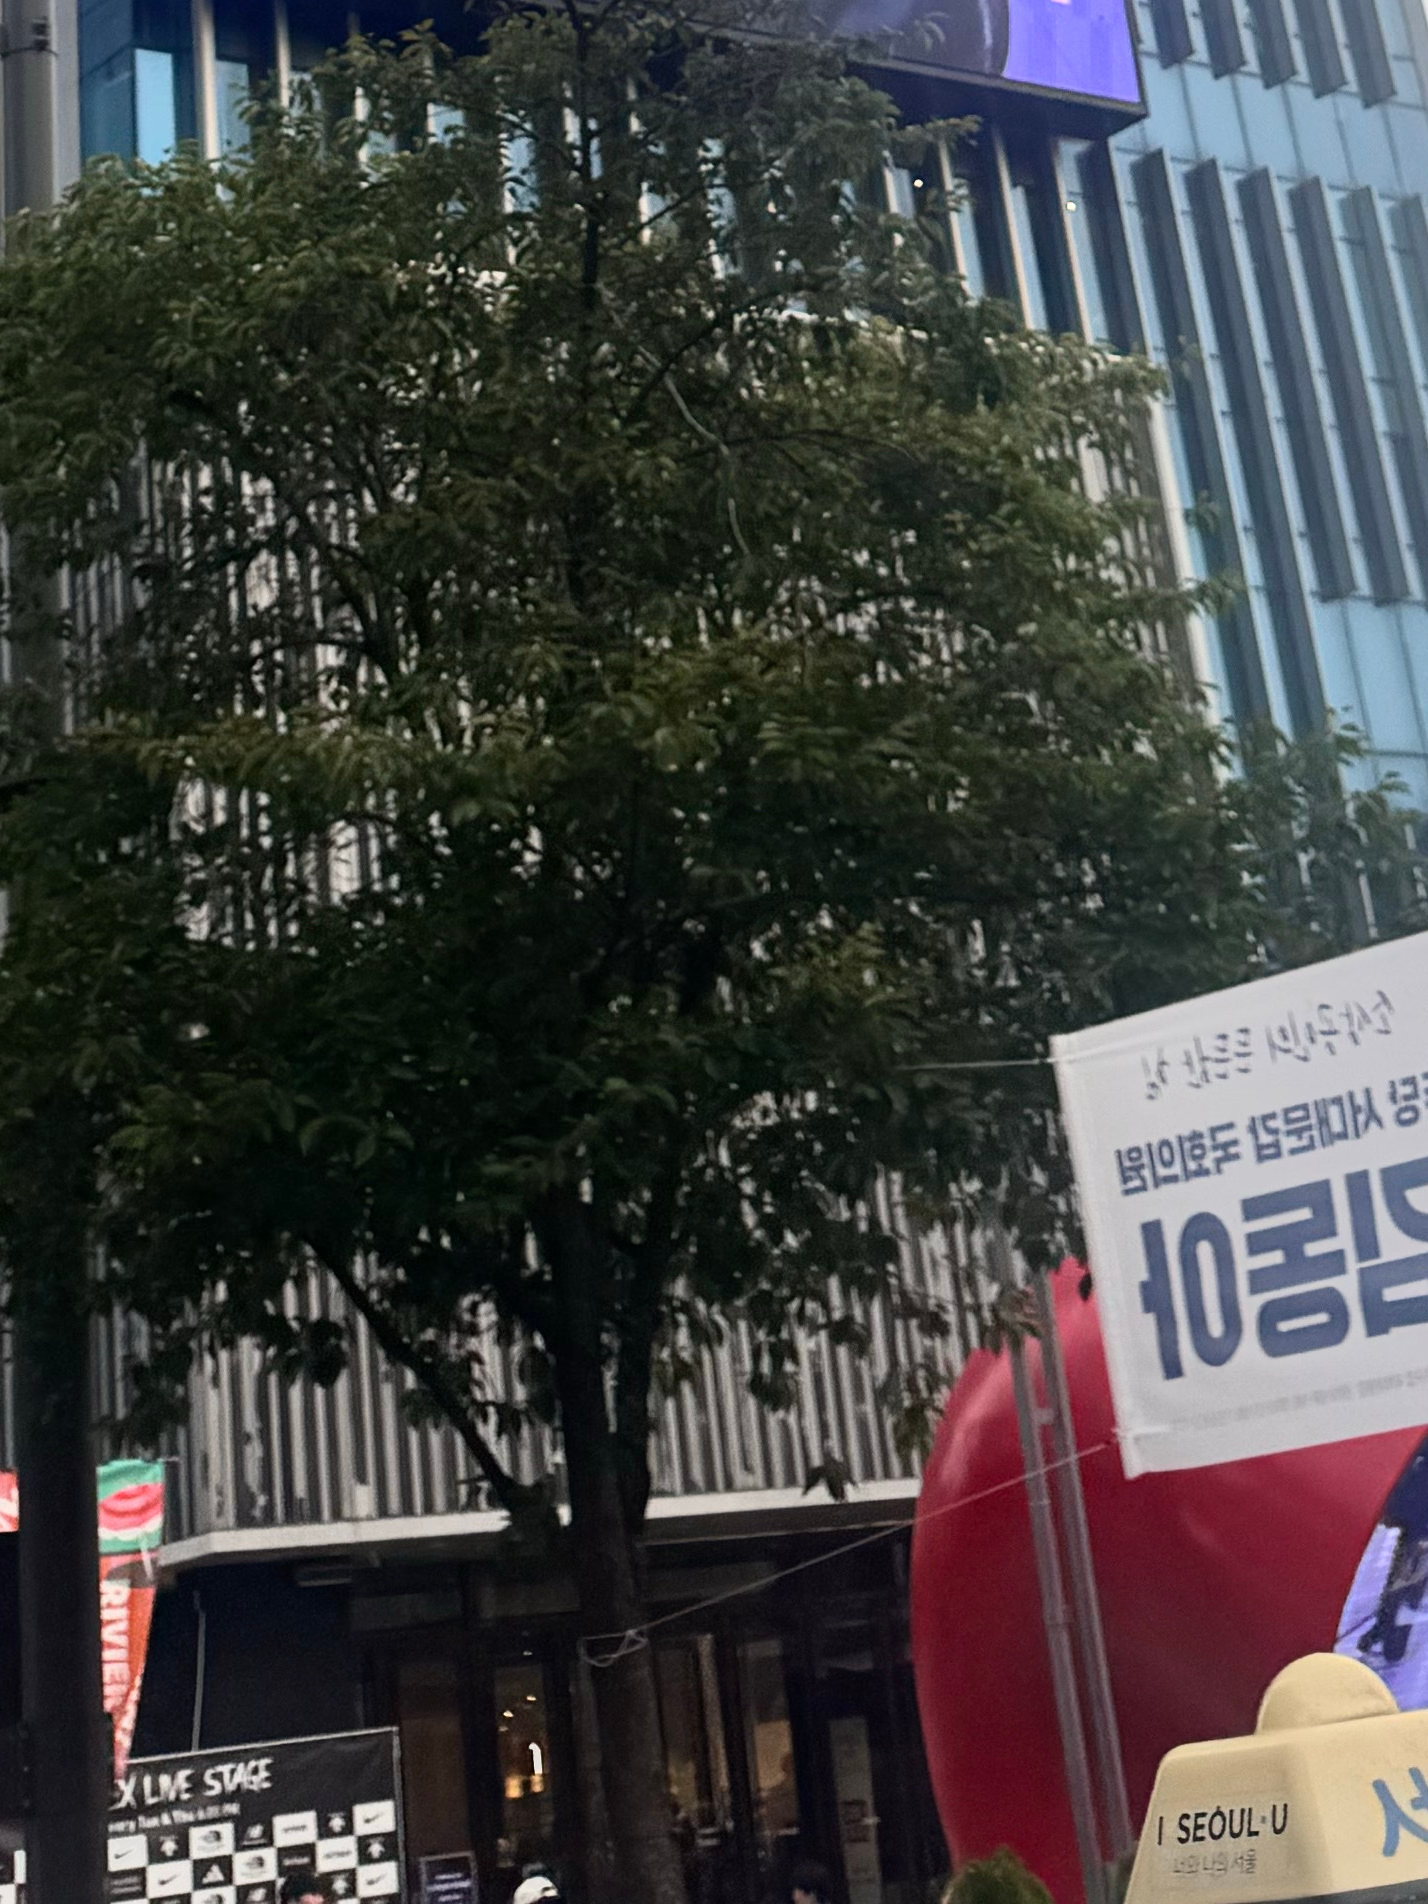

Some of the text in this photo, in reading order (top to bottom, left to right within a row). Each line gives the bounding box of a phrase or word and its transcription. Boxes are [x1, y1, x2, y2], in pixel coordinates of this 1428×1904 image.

[142, 1768, 195, 1805] LIVE
[202, 1757, 273, 1797] STAGE
[1176, 1805, 1260, 1845] SEOUL
[1272, 1802, 1288, 1835] U
